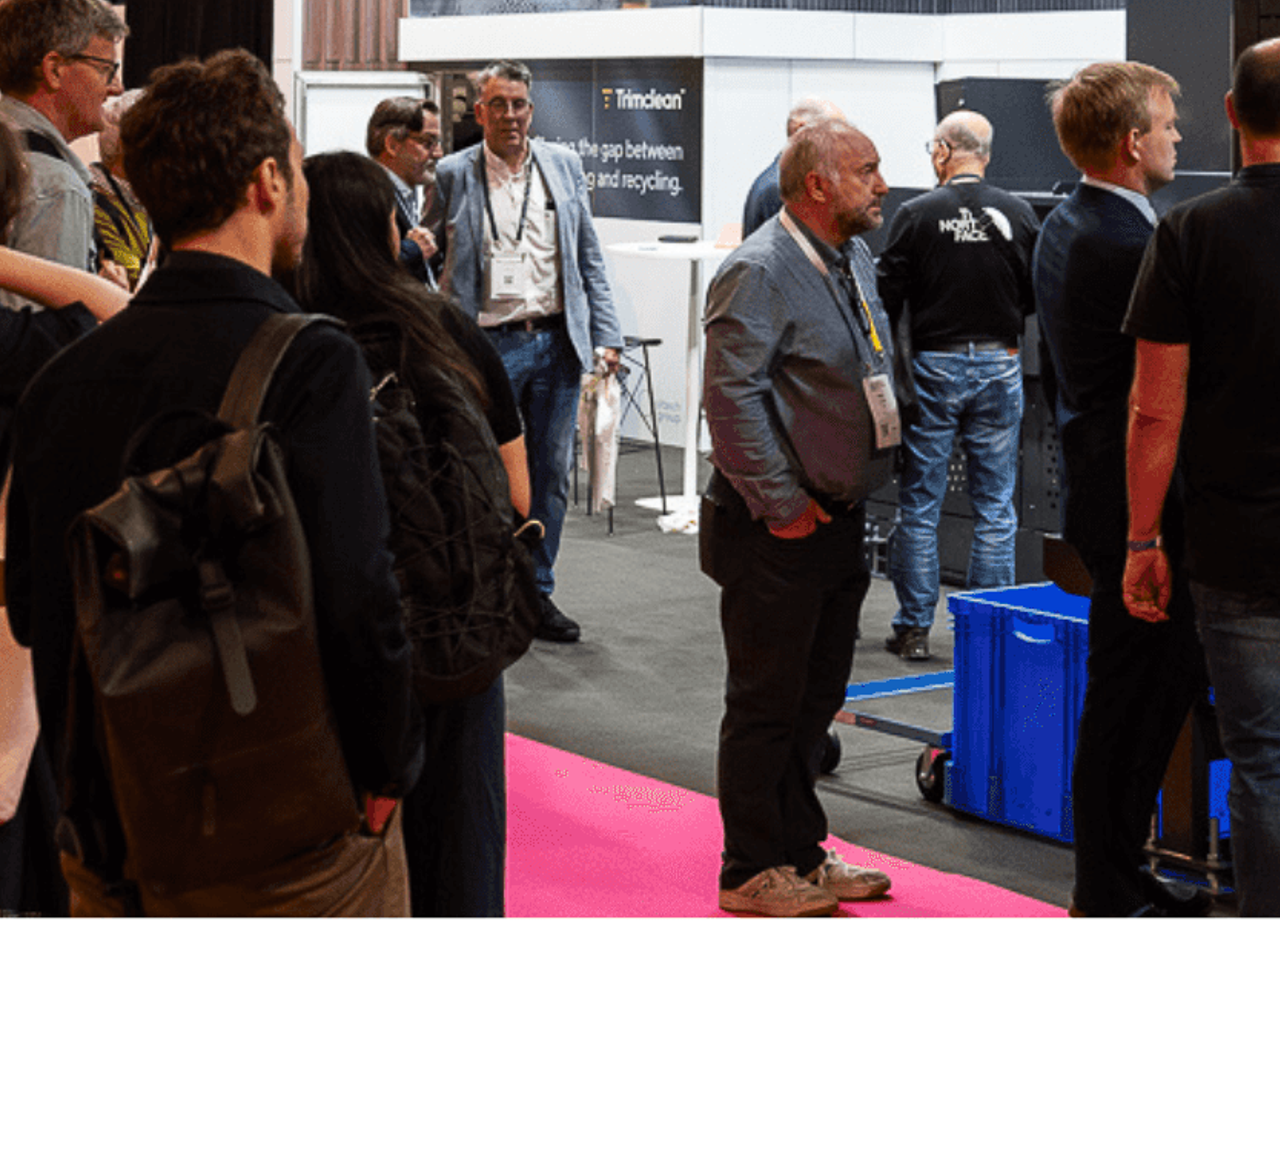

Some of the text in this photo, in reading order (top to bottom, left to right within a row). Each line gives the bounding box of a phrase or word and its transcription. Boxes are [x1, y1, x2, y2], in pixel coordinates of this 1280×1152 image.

[602, 143, 623, 162] gap
[624, 139, 684, 160] between
[597, 169, 619, 188] and
